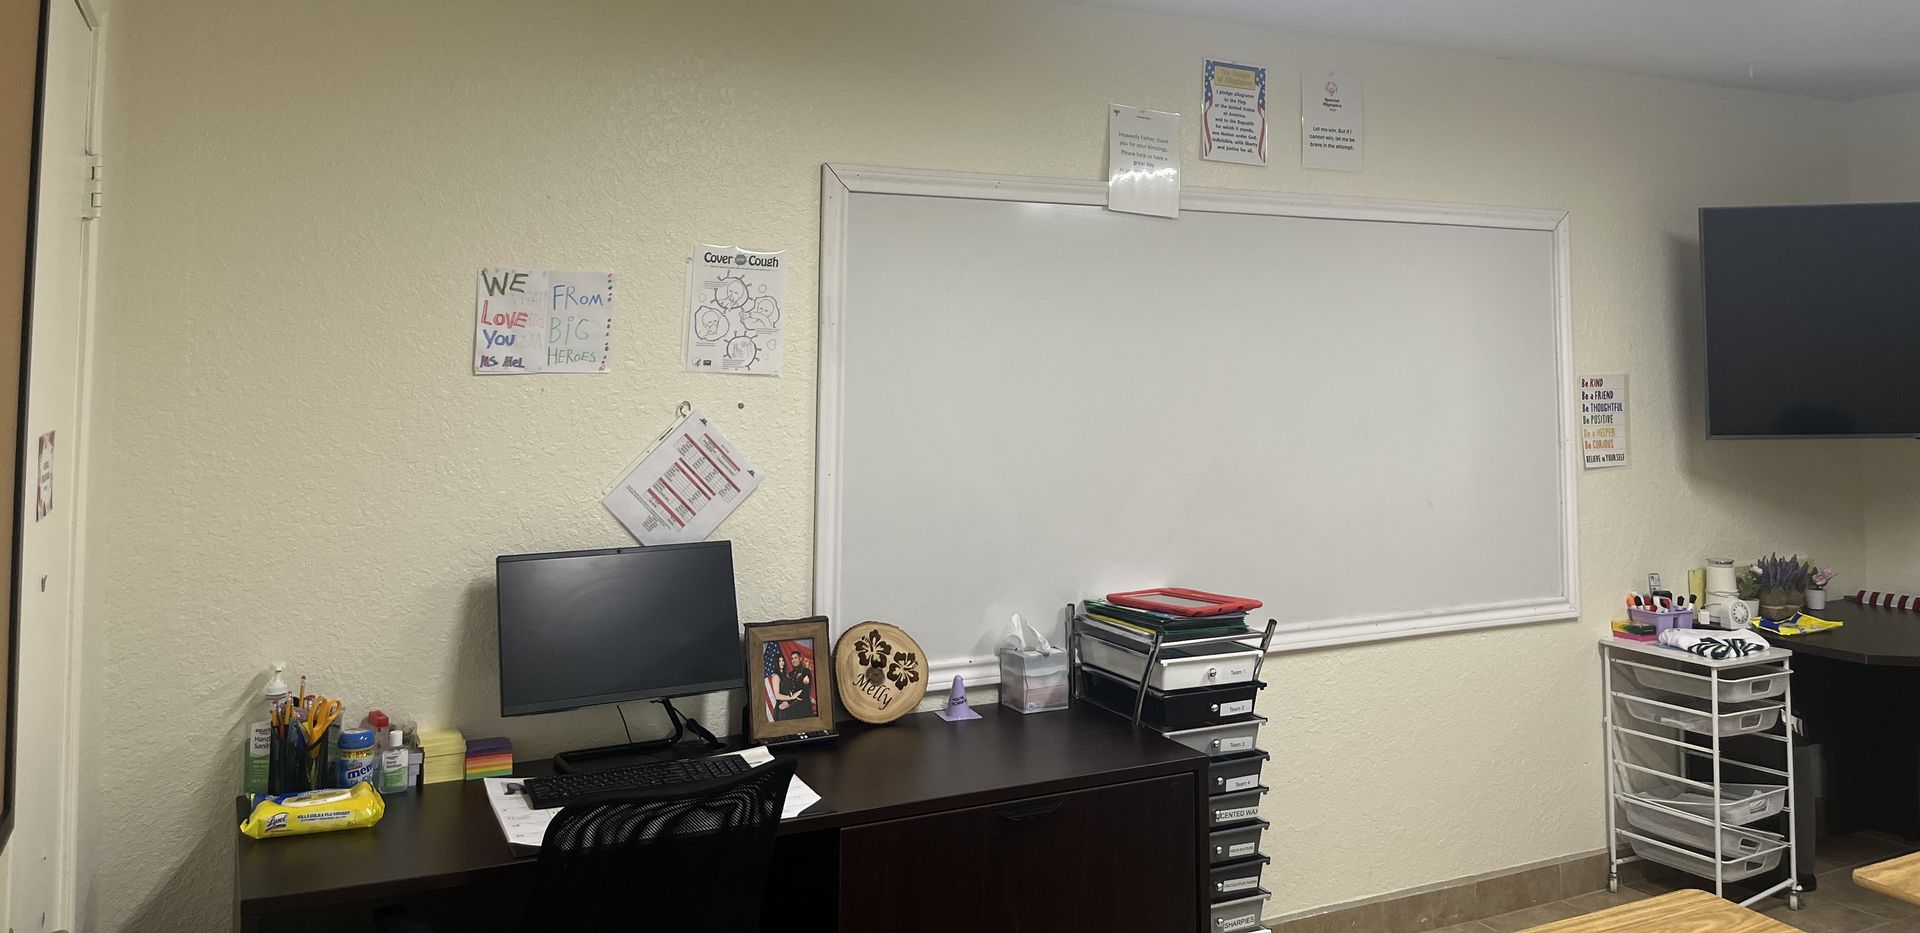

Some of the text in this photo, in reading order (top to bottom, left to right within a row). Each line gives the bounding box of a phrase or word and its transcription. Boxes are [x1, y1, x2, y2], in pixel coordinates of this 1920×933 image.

[1119, 131, 1139, 140] Heavenly
[704, 252, 733, 264] Cover
[749, 255, 779, 267] Cough
[482, 270, 528, 296] WE
[553, 285, 603, 310] FROM
[481, 300, 528, 329] LOVE
[1582, 378, 1603, 388] Be KIND
[1582, 391, 1588, 400] Be
[1595, 390, 1614, 400] FRIEND
[1582, 403, 1623, 412] Be THOUGHTFUL
[1583, 415, 1613, 424] Be POSITIVE
[1584, 428, 1590, 437] Be
[1596, 428, 1615, 437] HELPER
[1585, 440, 1614, 449] Be CURIOUS
[1586, 455, 1601, 463] BELIEVE
[1605, 453, 1624, 462] YOURSELF
[852, 673, 892, 710] Melly
[267, 815, 286, 827] Lysol
[1224, 916, 1255, 929] SHARPIES
